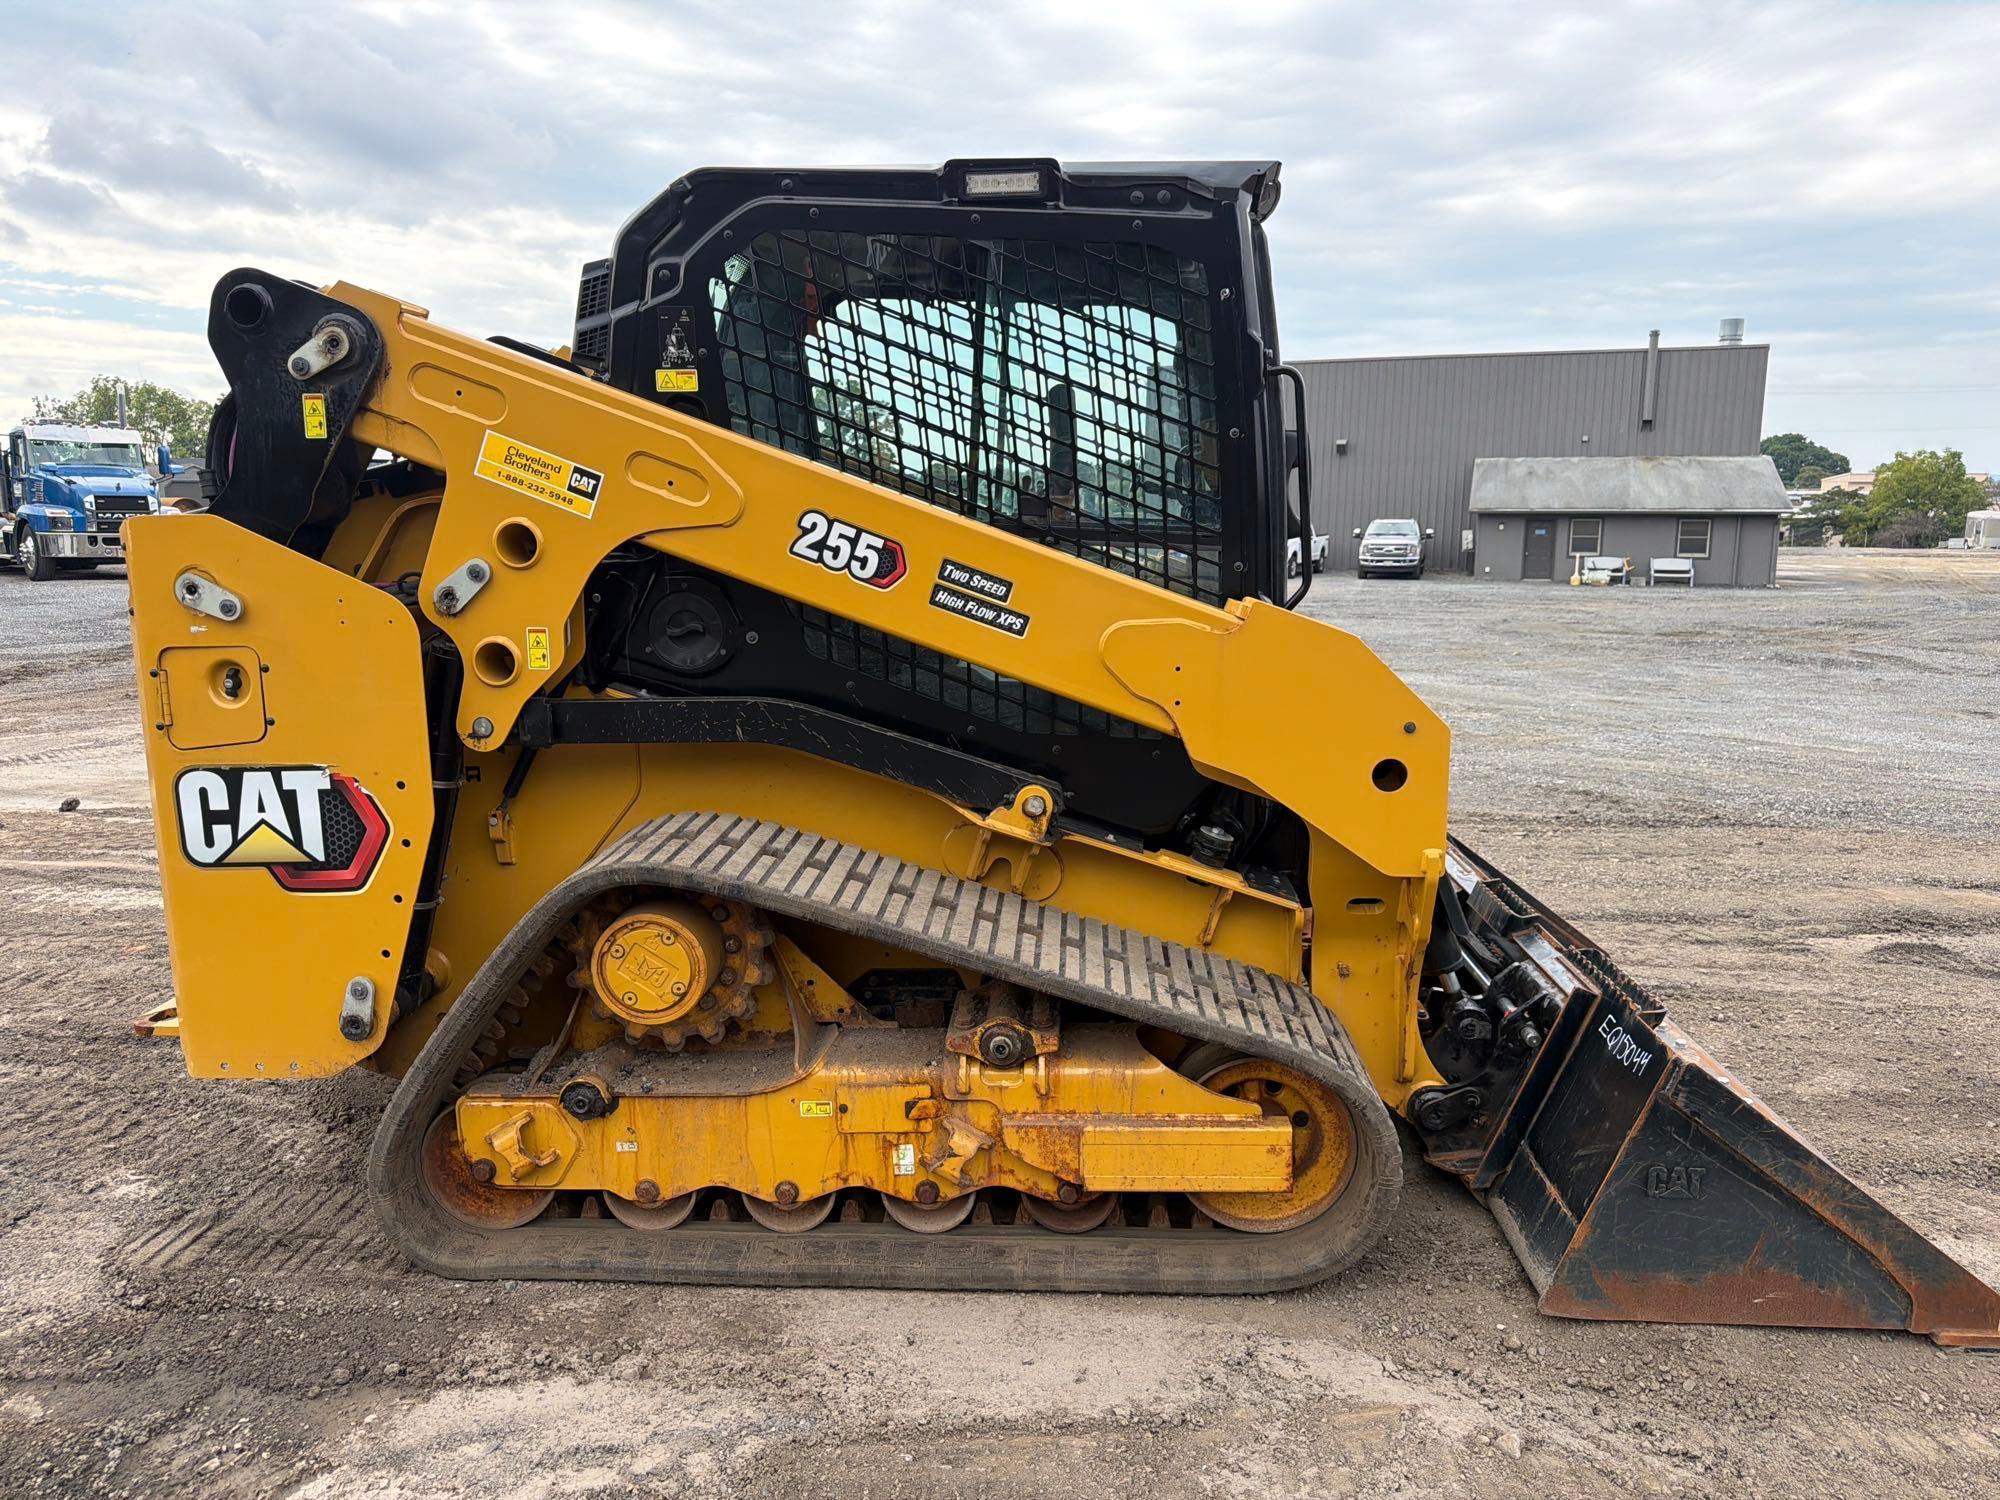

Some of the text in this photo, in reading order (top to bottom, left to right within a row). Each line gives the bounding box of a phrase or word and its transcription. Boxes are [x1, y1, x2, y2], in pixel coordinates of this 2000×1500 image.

[504, 455, 551, 480] Brothers
[507, 445, 562, 474] Cleveland
[497, 471, 574, 505] 1-888-232-5948
[570, 473, 597, 493] CAT
[792, 512, 885, 579] 255
[943, 565, 1007, 596] TWO SPEED
[935, 590, 1024, 630] HIGH FLOW XPS
[178, 770, 331, 863] CAT
[1598, 1014, 1652, 1076] EQ15044
[1647, 1165, 1706, 1200] CAT
